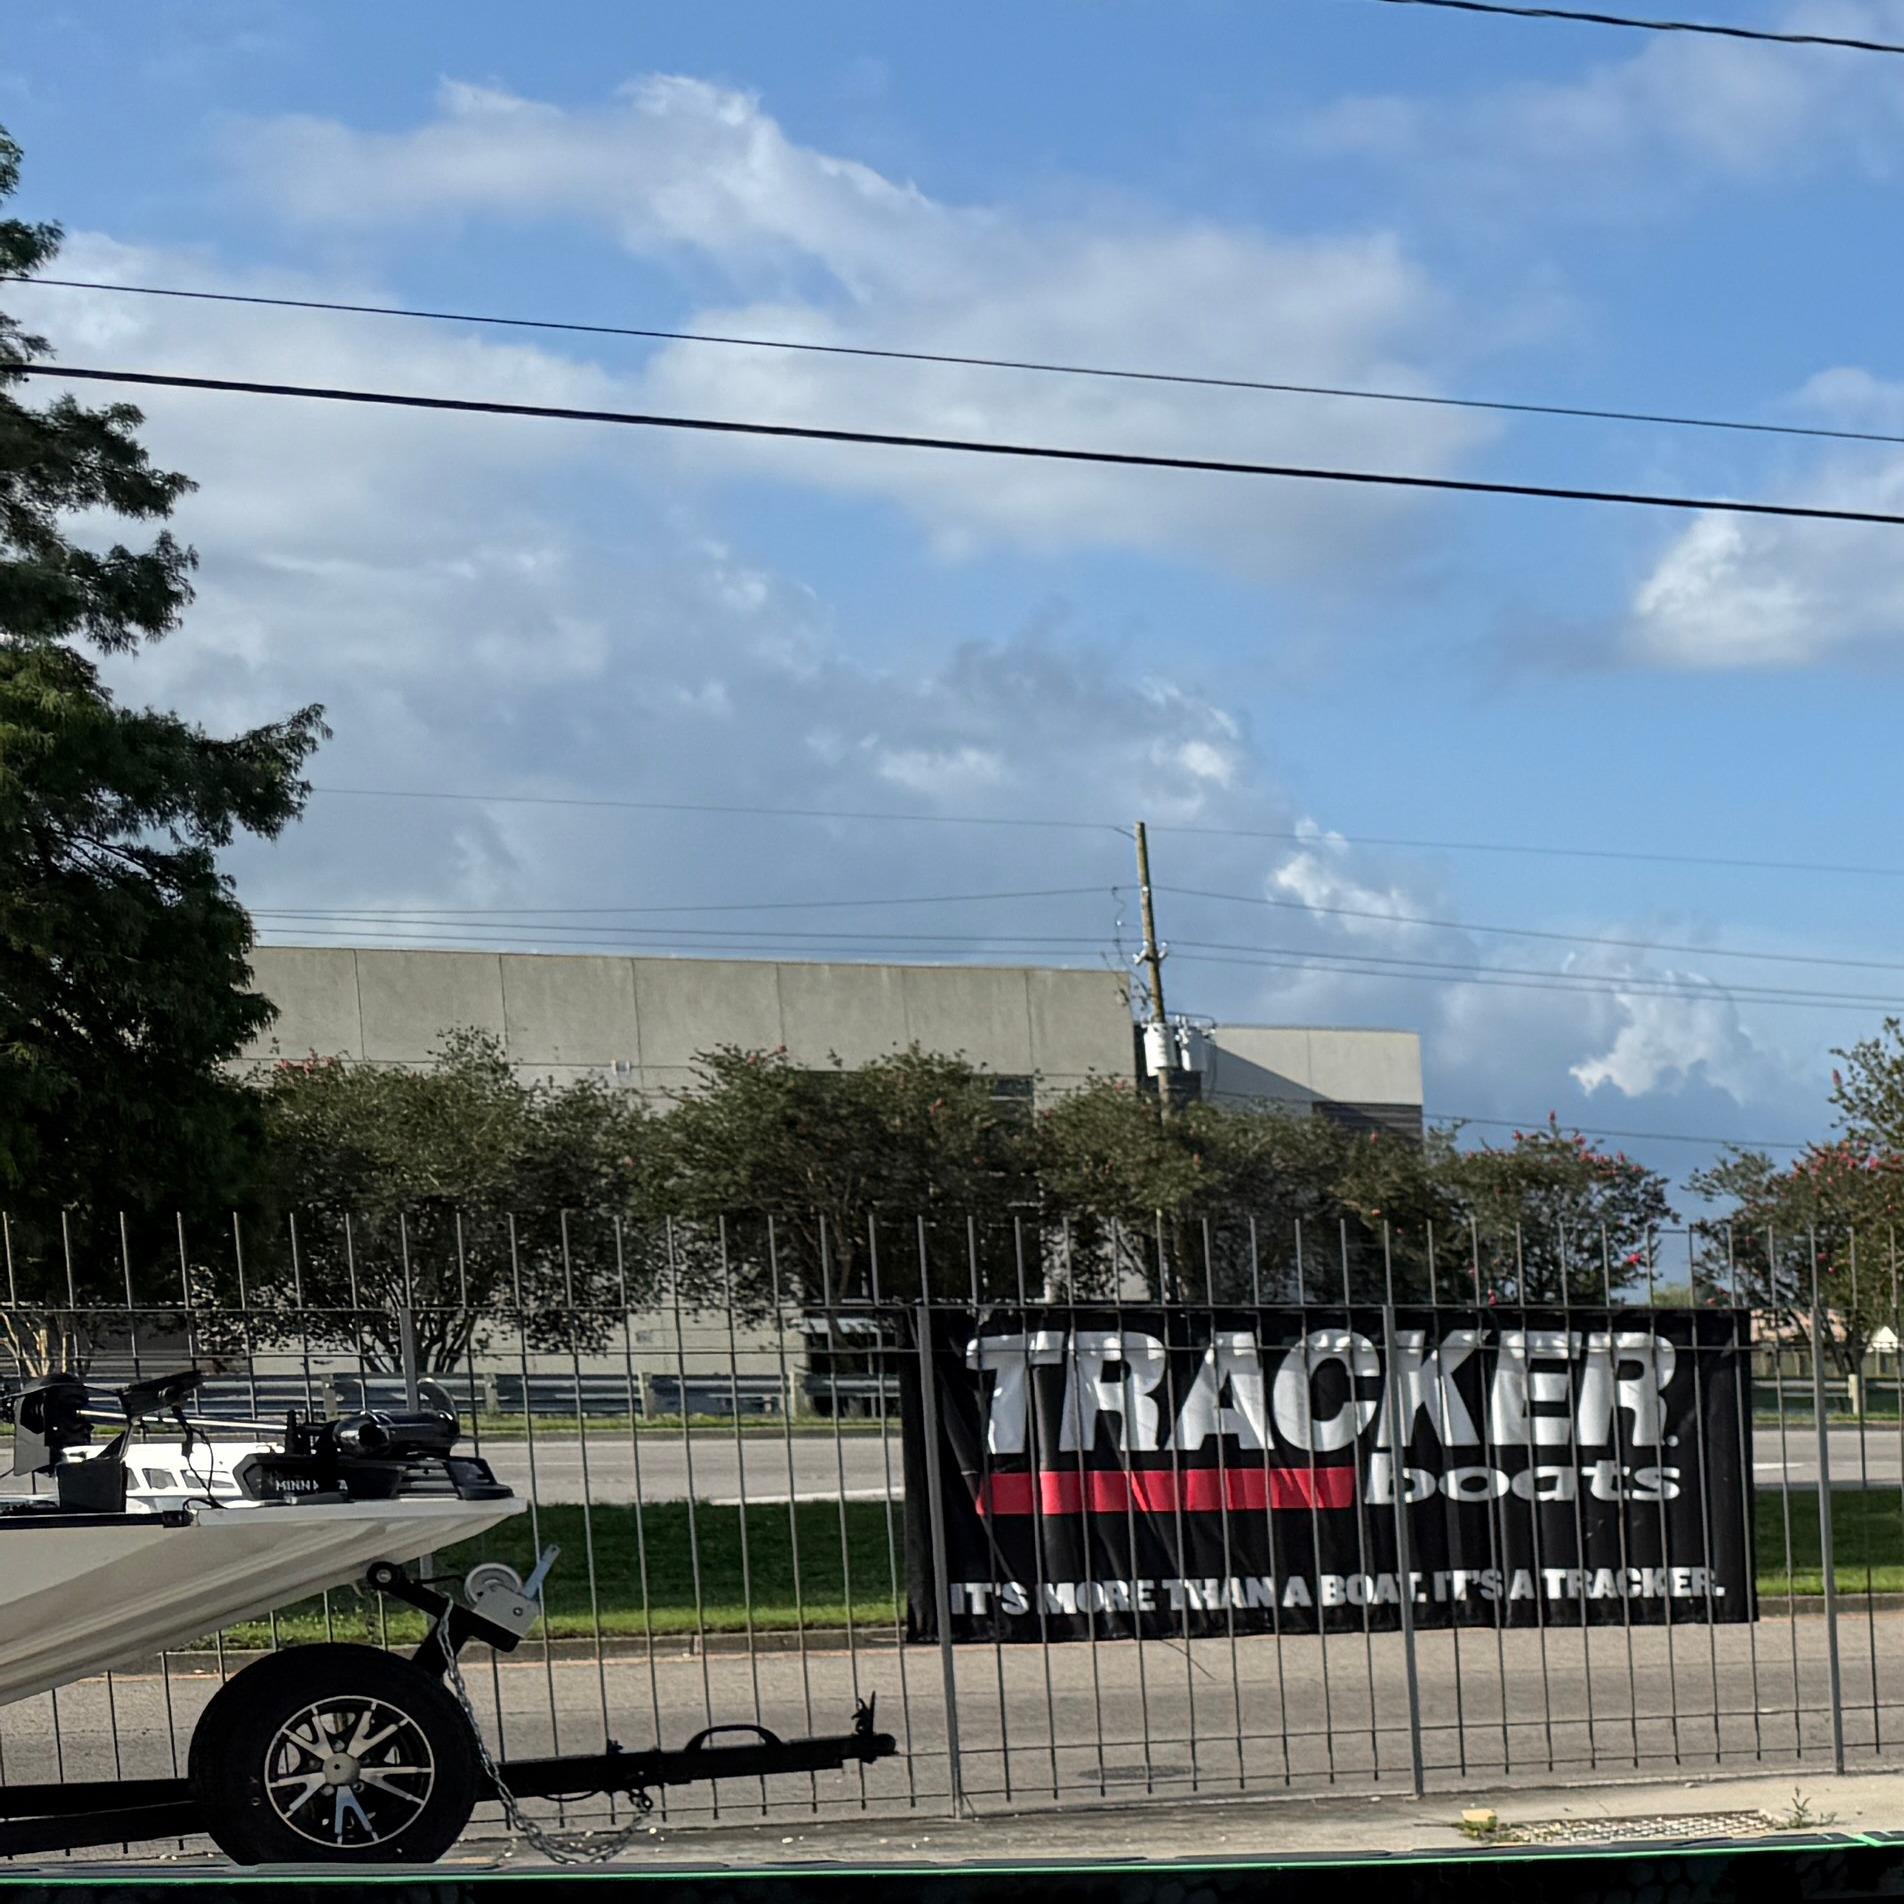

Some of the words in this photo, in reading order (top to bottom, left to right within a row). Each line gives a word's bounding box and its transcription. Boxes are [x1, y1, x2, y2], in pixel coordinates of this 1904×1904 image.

[964, 1328, 1681, 1454] TRACKER
[1365, 1452, 1681, 1505] boats
[950, 1581, 1029, 1615] IT'S
[1036, 1579, 1155, 1614] MORE
[1161, 1575, 1278, 1611] THAN
[1282, 1575, 1313, 1607] A
[1433, 1569, 1504, 1602] IT'S
[1509, 1568, 1536, 1600] A
[1540, 1566, 1726, 1601] TRACKER.
